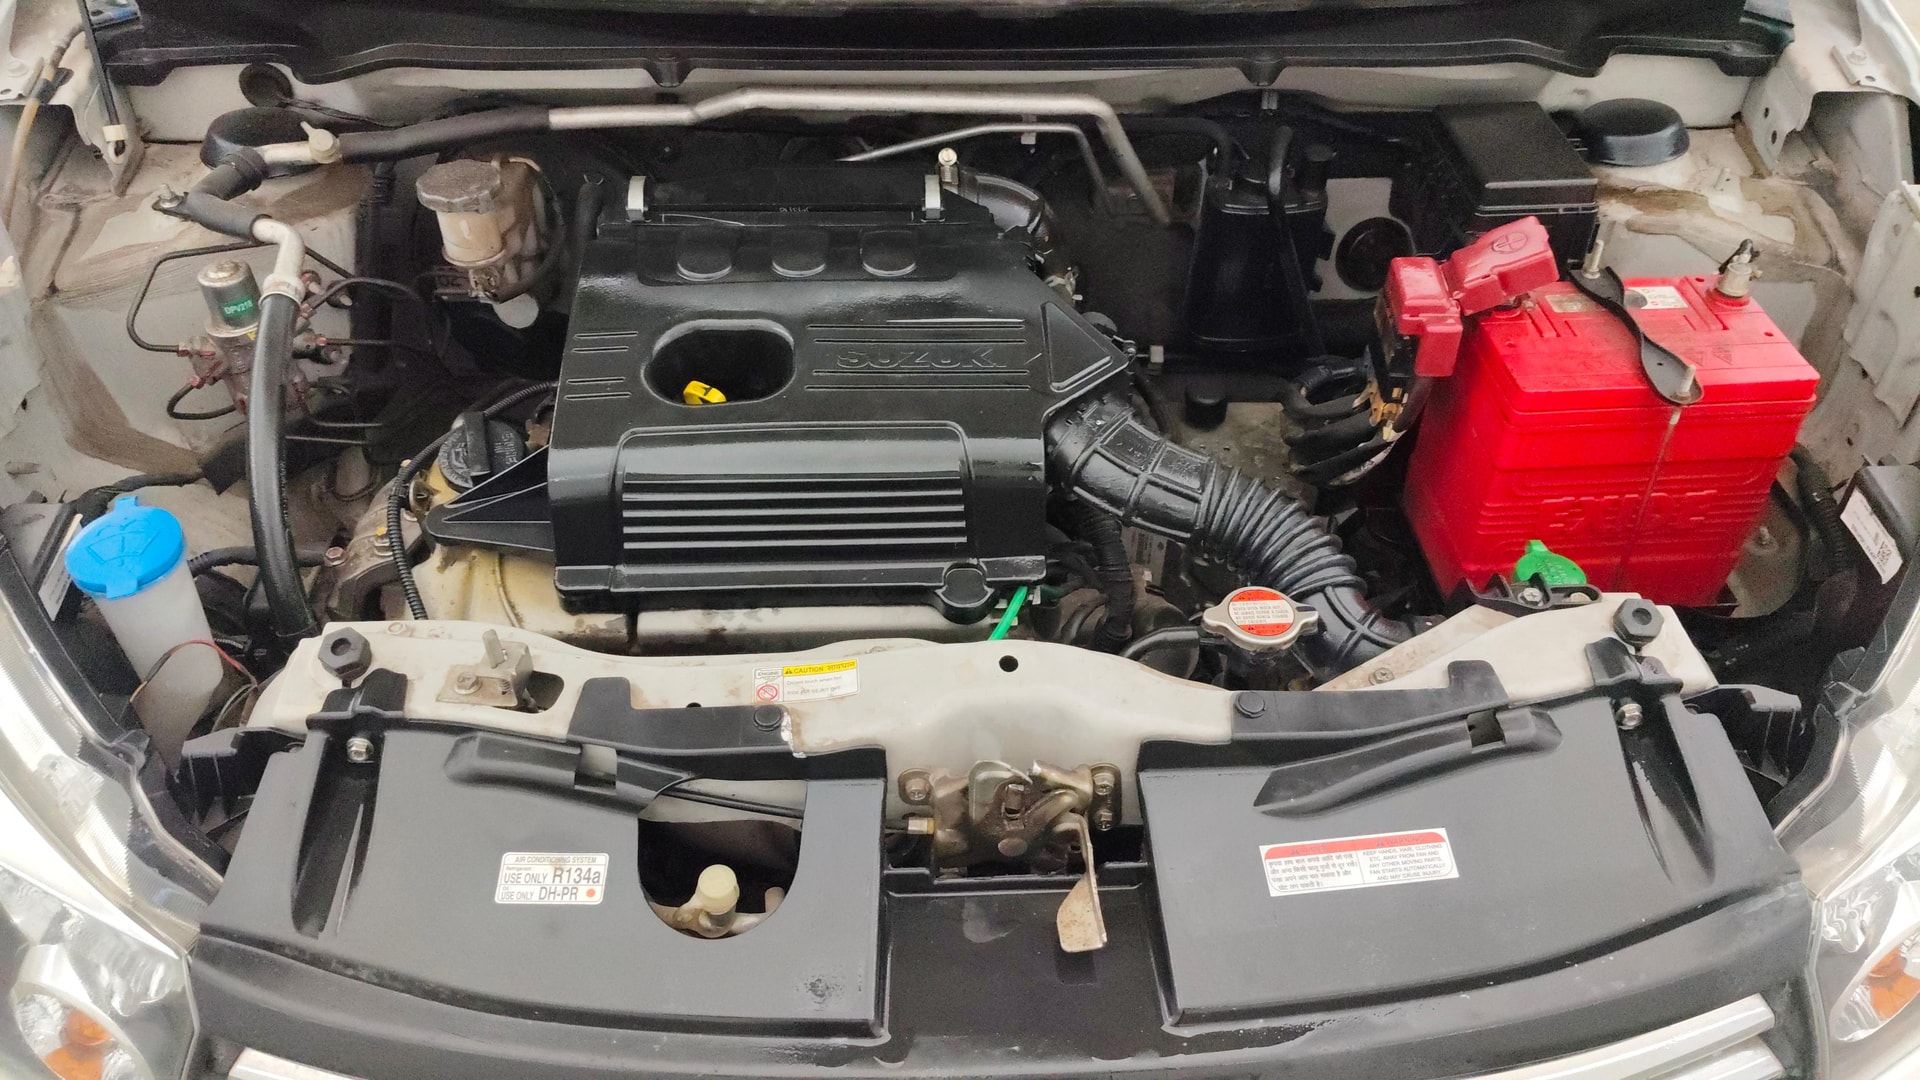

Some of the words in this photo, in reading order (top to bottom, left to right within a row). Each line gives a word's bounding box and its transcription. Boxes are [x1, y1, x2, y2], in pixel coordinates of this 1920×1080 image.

[836, 347, 1007, 368] SUZUKI
[1404, 863, 1446, 871] AUTOMATICALLY
[504, 873, 522, 884] USE
[524, 873, 548, 884] ONLY
[552, 867, 601, 884] R134a
[501, 892, 516, 900] USE
[516, 892, 534, 900] ONLY
[538, 886, 579, 900] DH-PR
